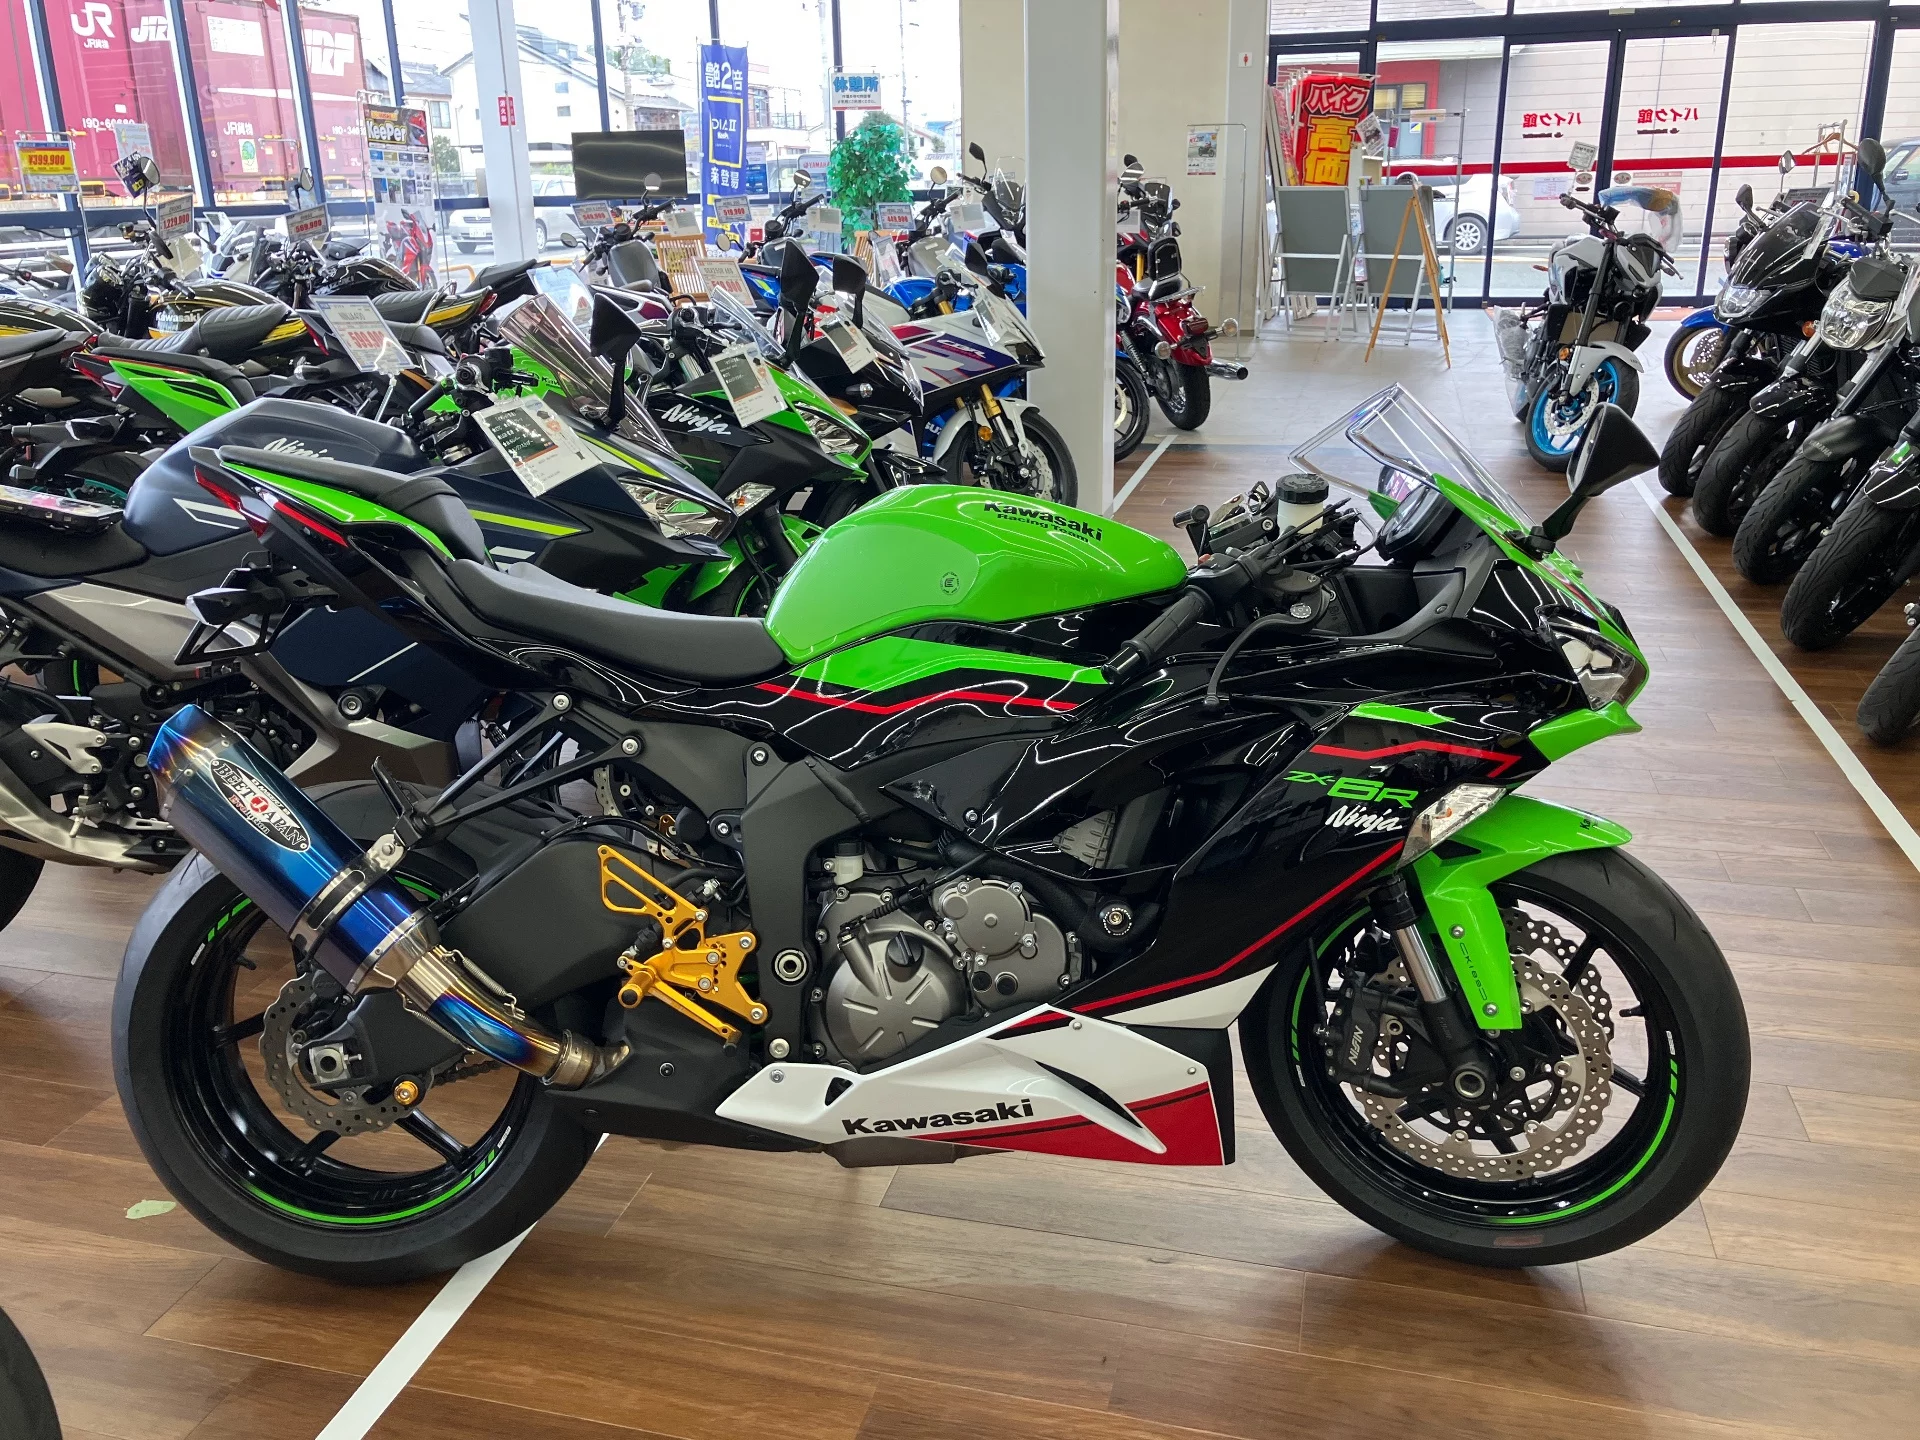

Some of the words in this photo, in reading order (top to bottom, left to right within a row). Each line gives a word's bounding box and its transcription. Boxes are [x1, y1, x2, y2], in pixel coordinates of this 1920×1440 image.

[70, 1, 116, 38] JR
[705, 61, 743, 91] 艶2倍
[833, 76, 879, 92] 休憩所
[1305, 83, 1370, 115] バイク
[366, 120, 406, 142] KeePer
[1303, 115, 1358, 186] 高価
[155, 310, 201, 324] Kawasaki
[661, 403, 732, 435] Ninja
[983, 501, 1103, 541] Kawasaki
[997, 513, 1049, 529] Racing
[1053, 524, 1090, 543] Team
[213, 762, 257, 800] BEET
[249, 796, 306, 846] JAPAN
[1283, 770, 1419, 809] ZX-6R
[1324, 804, 1403, 836] Ninja
[841, 1098, 1034, 1136] Kawasaki
